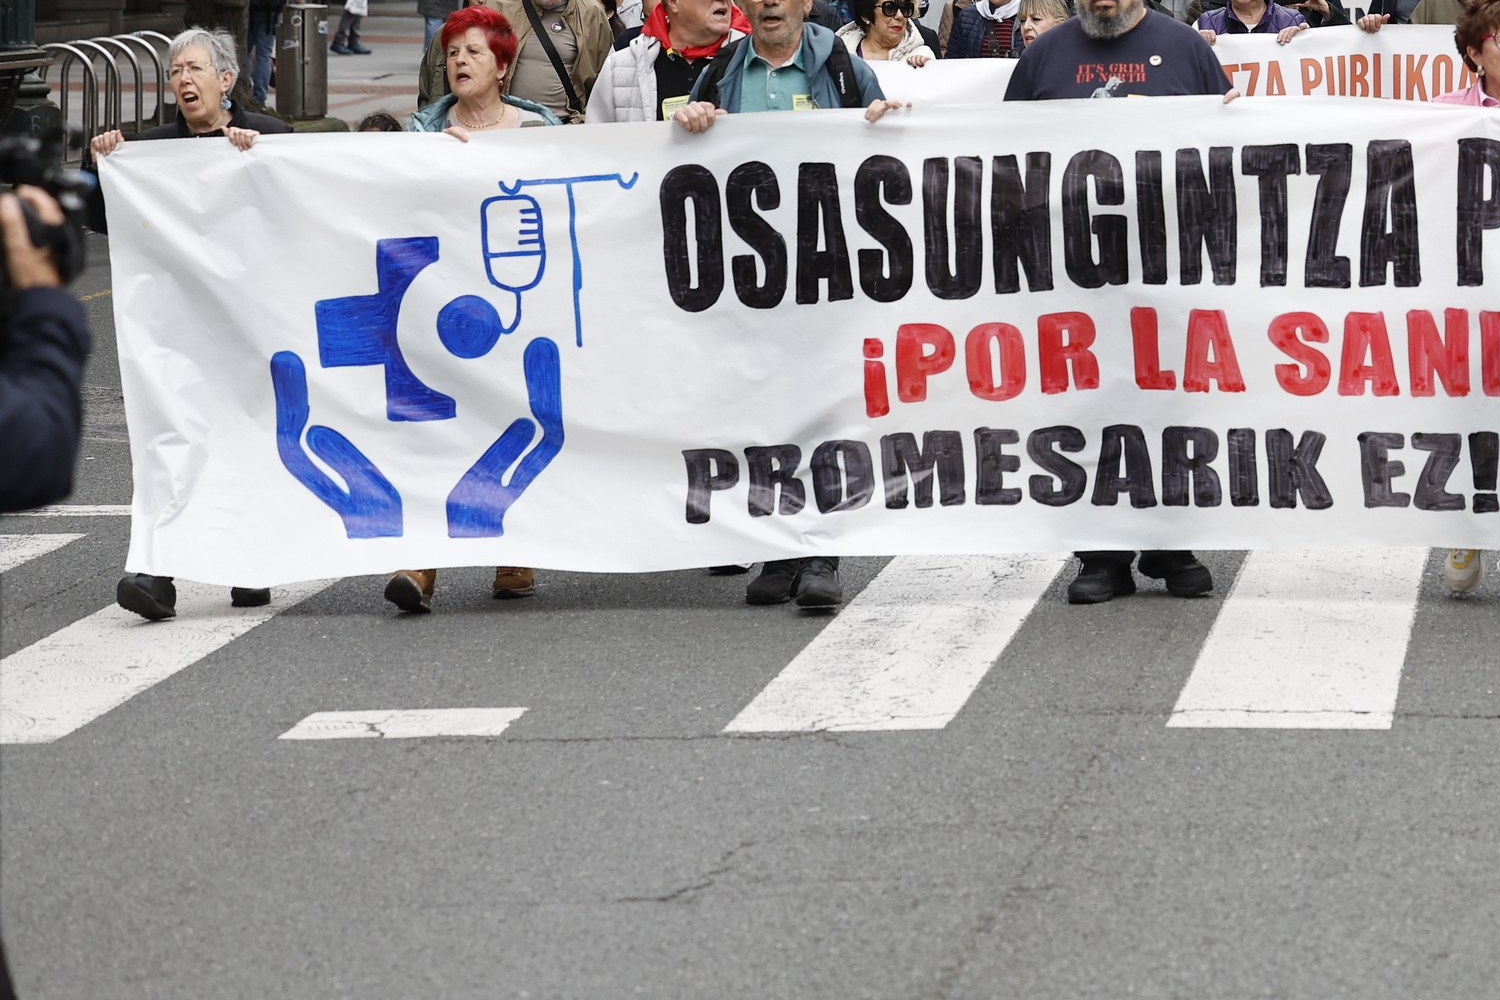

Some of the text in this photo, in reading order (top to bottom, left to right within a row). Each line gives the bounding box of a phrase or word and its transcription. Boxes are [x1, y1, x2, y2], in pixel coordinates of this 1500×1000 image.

[1075, 73, 1095, 84] UP
[1078, 63, 1146, 74] IT'S GRIM
[659, 139, 1422, 312] OSASUNGINTZA
[862, 311, 1100, 419] ¡POR
[1130, 306, 1247, 394] LA
[681, 424, 1334, 525] PROMESARIK
[1356, 430, 1500, 515] EZ!
